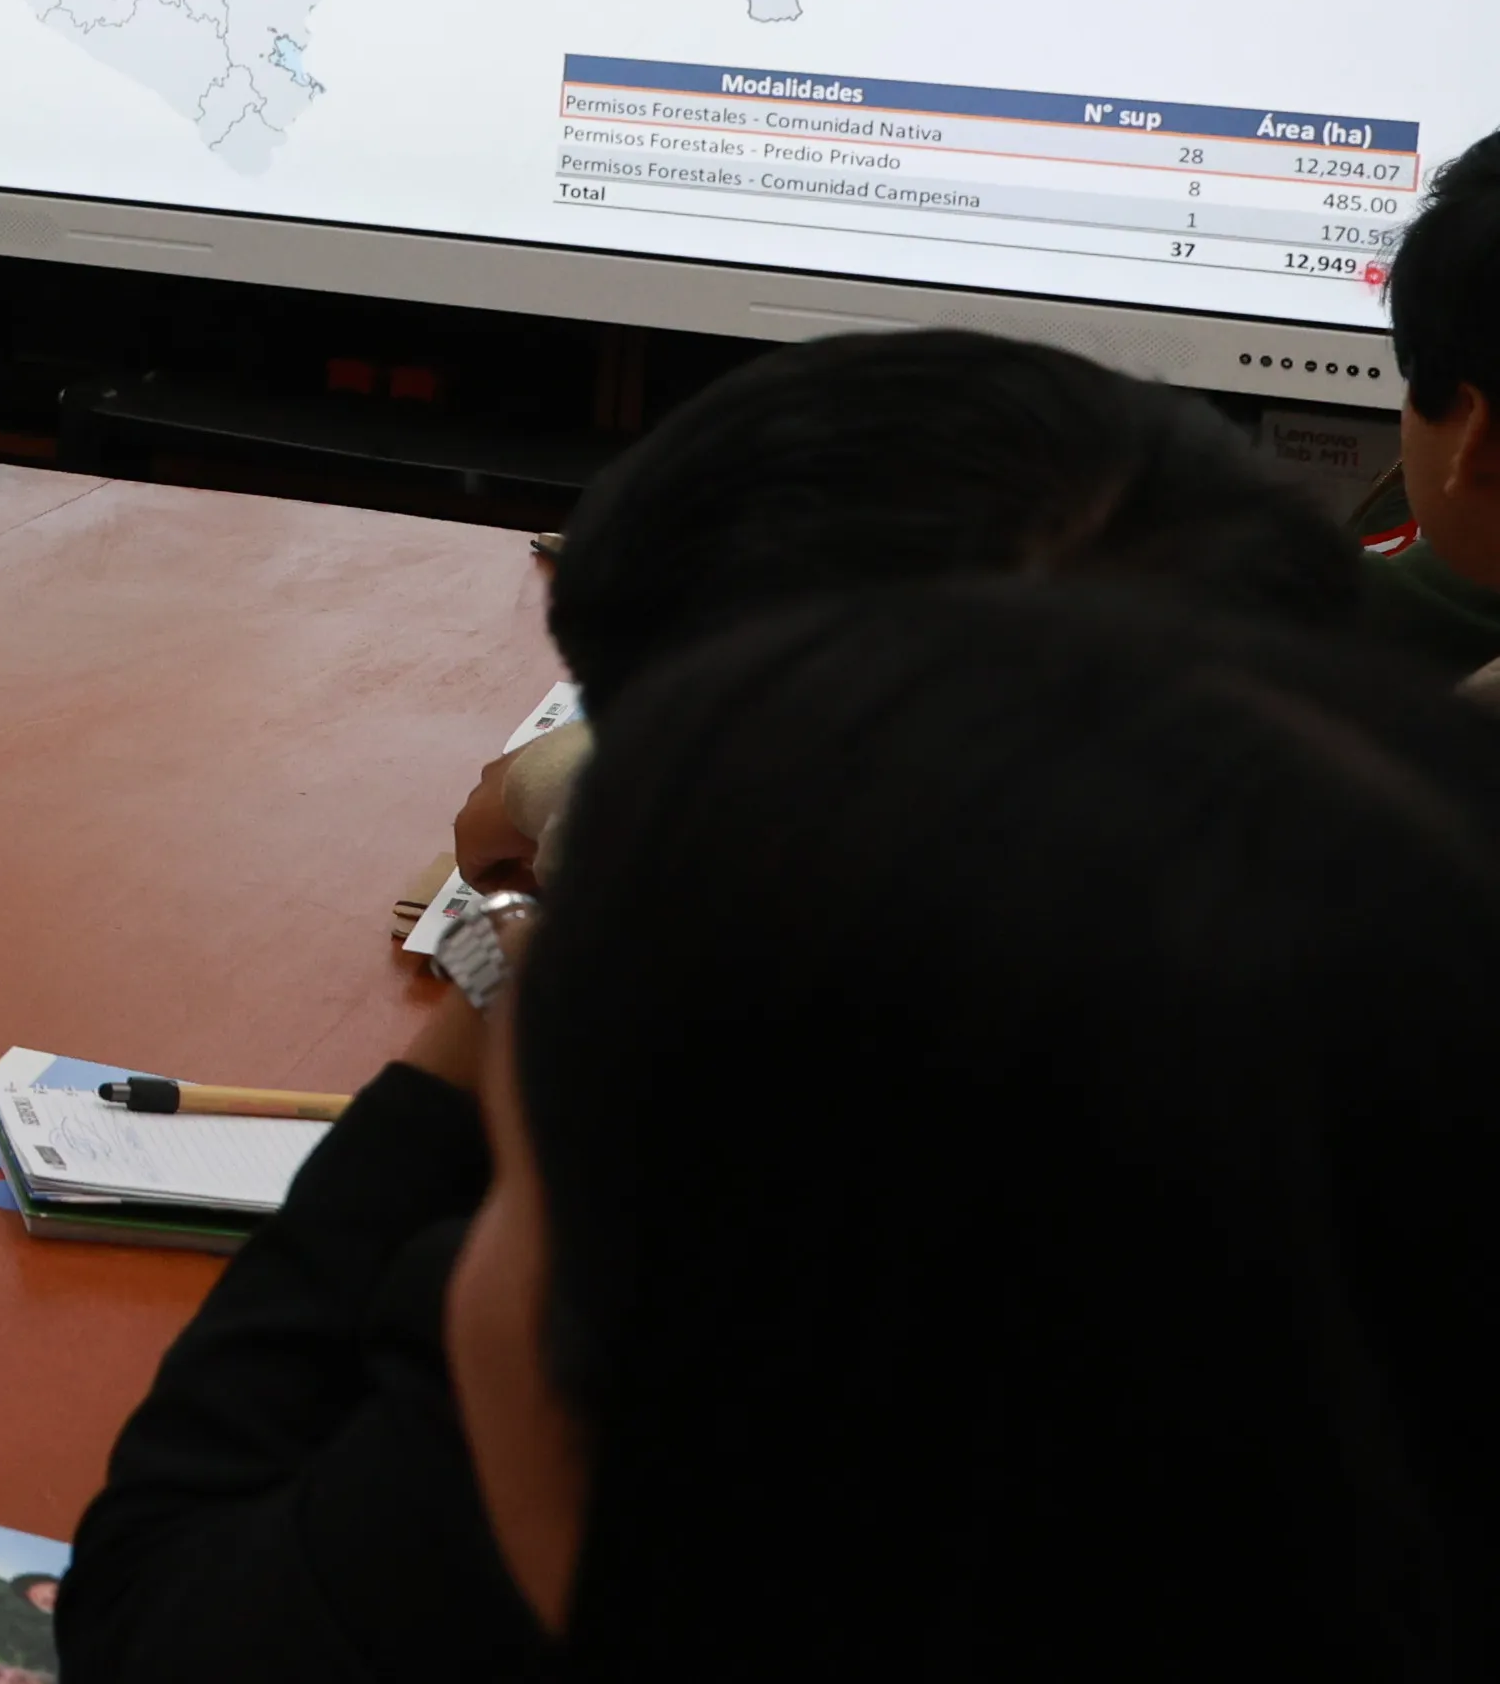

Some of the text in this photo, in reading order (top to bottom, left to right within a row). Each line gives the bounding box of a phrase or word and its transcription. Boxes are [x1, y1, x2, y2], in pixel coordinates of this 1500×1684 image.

[565, 95, 1401, 183] Permisos Forestales Comunidad Nativa 28 12,294.07
[721, 72, 864, 104] Modalidades
[1118, 107, 1162, 132] sup
[1256, 113, 1316, 142] Área
[1323, 121, 1374, 149] (ha)
[561, 154, 643, 177] Permisos
[648, 163, 743, 186] Forestales
[760, 173, 870, 199] Comunidad
[874, 184, 981, 209] Campesina
[1186, 213, 1197, 228] 1
[563, 125, 1398, 215] Permisos Forestales Predio Privado 8 485.00
[559, 183, 607, 202] Total
[1170, 241, 1196, 259] 37
